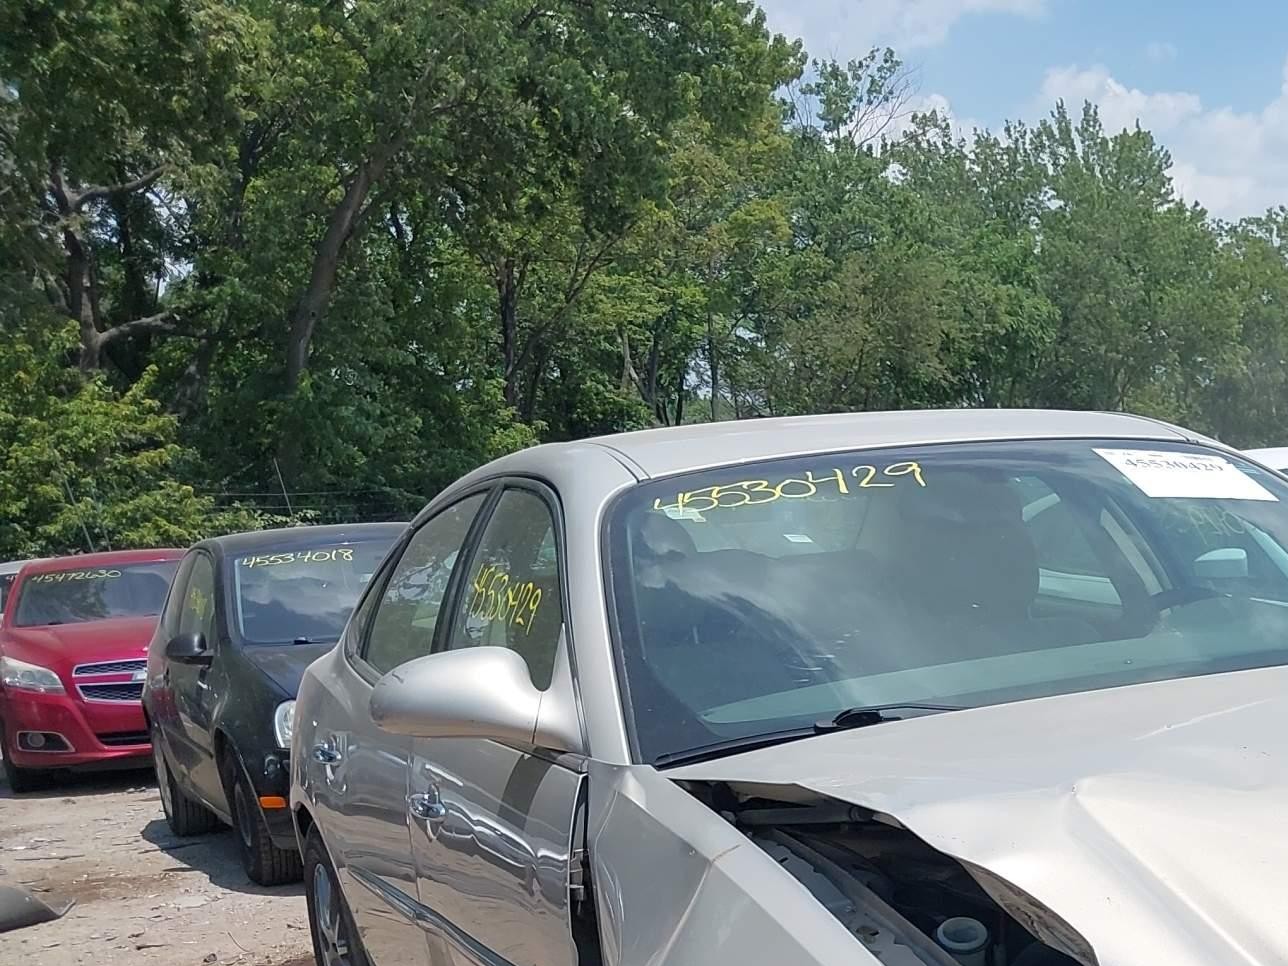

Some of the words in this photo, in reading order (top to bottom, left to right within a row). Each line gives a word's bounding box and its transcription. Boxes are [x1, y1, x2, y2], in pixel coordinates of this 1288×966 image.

[653, 461, 926, 517] 45530429
[242, 548, 353, 568] 45534018
[469, 563, 541, 636] 45530429
